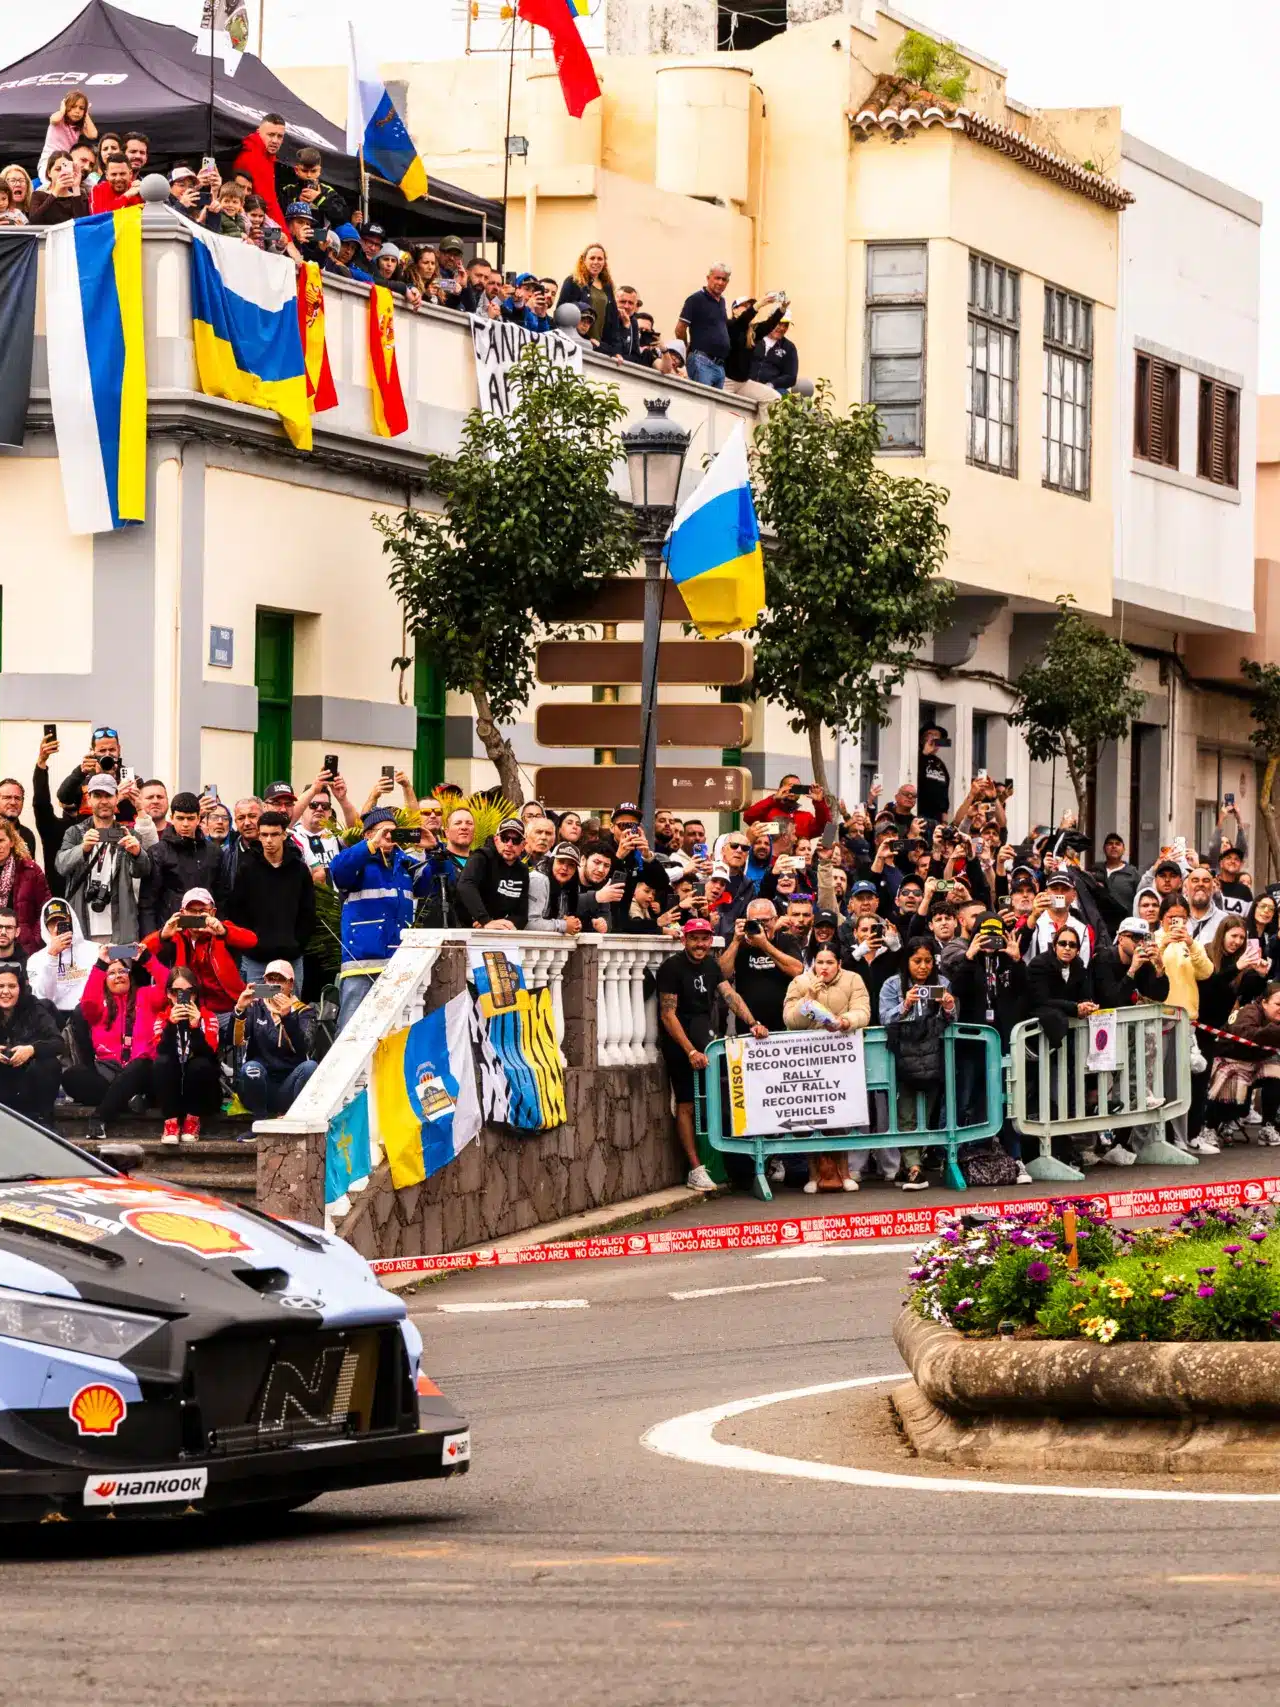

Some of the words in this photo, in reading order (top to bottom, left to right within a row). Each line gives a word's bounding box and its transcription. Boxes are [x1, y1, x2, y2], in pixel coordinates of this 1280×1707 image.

[1224, 899, 1243, 914] LA
[748, 1047, 781, 1059] SÓLO
[784, 1042, 854, 1056] VEHÍCULOS
[746, 1054, 857, 1071] RECONOCIMIENTO
[782, 1069, 822, 1081] RALLY
[732, 1065, 745, 1110] AVISO
[765, 1083, 799, 1095] ONLY
[802, 1080, 841, 1091] RALLY
[762, 1092, 847, 1107] RECOGNITION
[775, 1105, 836, 1119] VEHICLES
[1132, 1192, 1155, 1203] ZONA
[1158, 1187, 1203, 1200] PROHIBIDO
[1205, 1184, 1241, 1198] PUBLICO
[978, 1205, 1001, 1216] ZONA
[1003, 1201, 1048, 1215] PROHIBIDO
[1134, 1203, 1161, 1214] NO-GO
[1162, 1201, 1184, 1213] AREA
[824, 1217, 847, 1228] ZONA
[849, 1214, 894, 1227] PROHIBIDO
[897, 1210, 932, 1222] PUBLICO
[671, 1230, 694, 1240] ZONA
[696, 1227, 740, 1239] PROHIBIDO
[743, 1223, 779, 1234] PUBLICO
[825, 1228, 852, 1239] NO-GO
[853, 1226, 876, 1238] AREA
[881, 1225, 893, 1235] NO
[894, 1222, 931, 1234] GO-AREA
[544, 1240, 588, 1250] PROHIBIDO
[590, 1236, 625, 1247] PUBLICO
[672, 1240, 699, 1251] NO-GO
[700, 1238, 722, 1249] AREA
[727, 1236, 739, 1247] NO
[740, 1234, 777, 1246] GO-AREA
[520, 1251, 547, 1262] NO-GO
[548, 1250, 570, 1260] AREA
[575, 1248, 587, 1259] NO
[587, 1246, 625, 1257] GO-AREA
[395, 1260, 418, 1271] AREA
[423, 1259, 435, 1269] NO
[436, 1256, 473, 1268] GO-AREA
